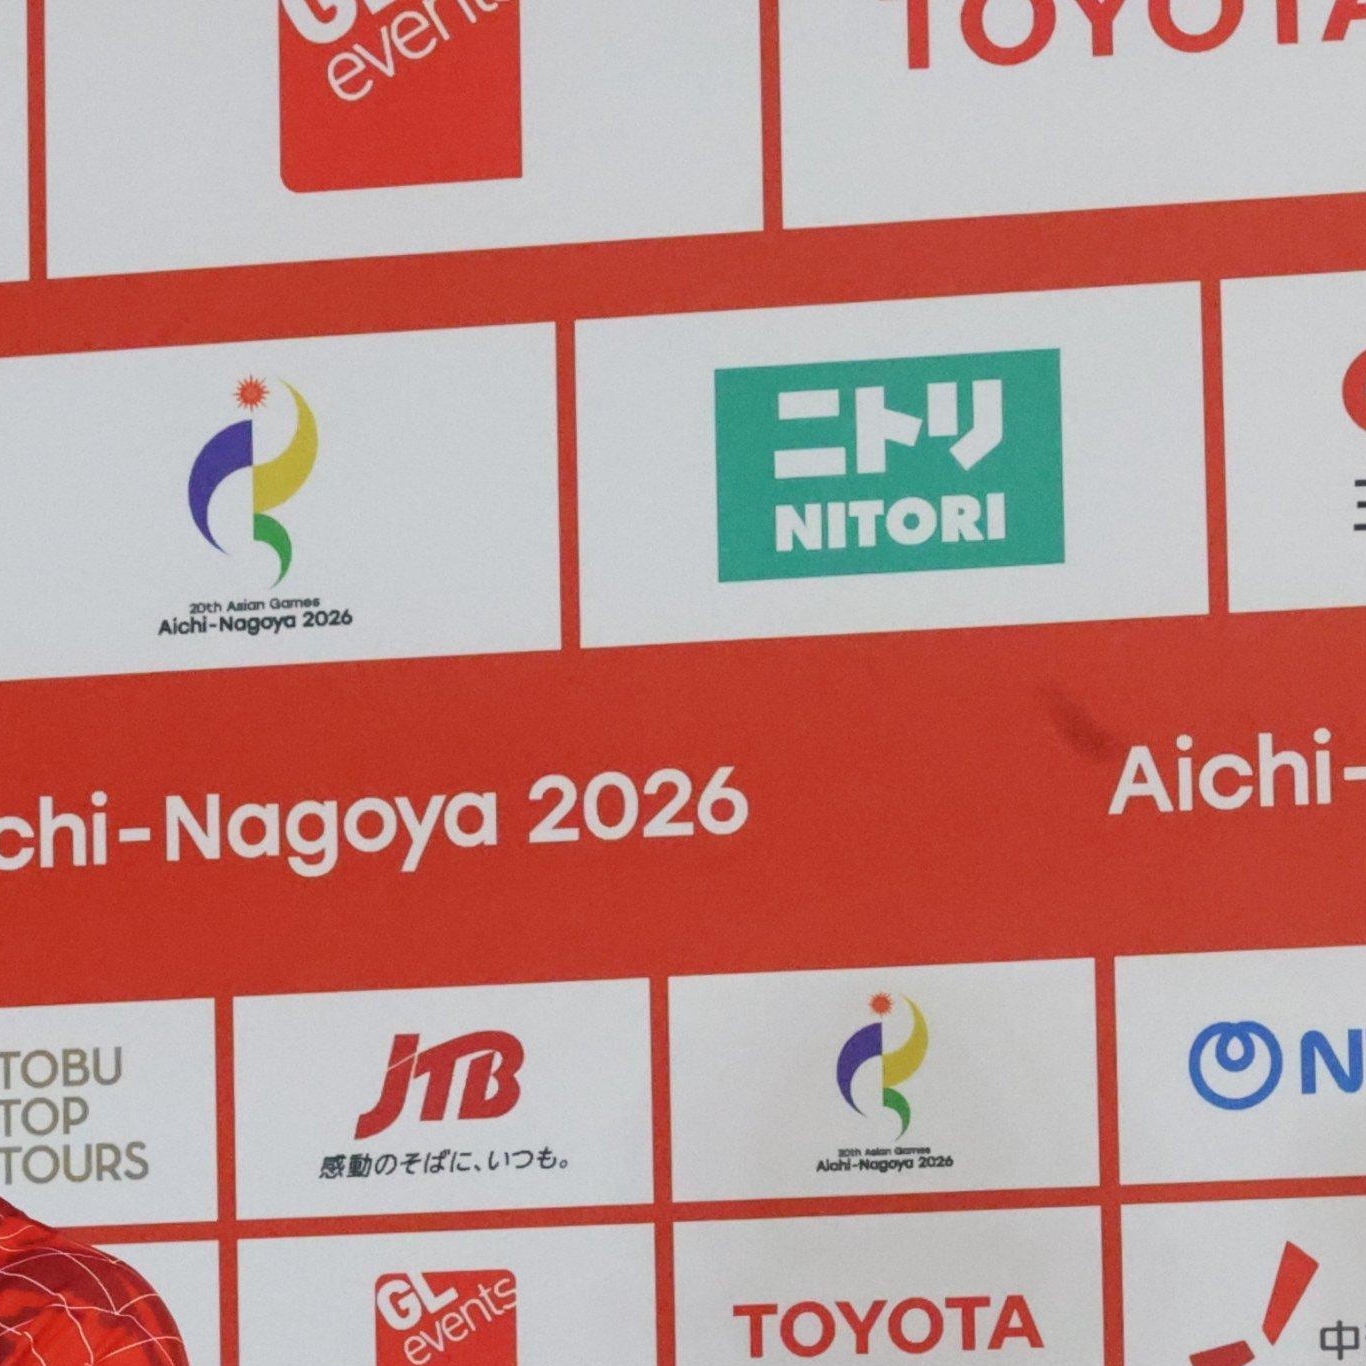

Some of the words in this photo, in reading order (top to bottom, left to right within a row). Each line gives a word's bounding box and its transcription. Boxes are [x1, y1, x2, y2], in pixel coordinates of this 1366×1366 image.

[774, 379, 1004, 479] ニトリ
[775, 492, 1006, 553] NITORI
[158, 613, 296, 636] Aichi-Nagoya
[302, 609, 353, 627] 2026
[189, 601, 222, 614] 20th
[227, 598, 265, 612] Asian
[269, 597, 321, 610] Games
[528, 766, 749, 845] 2026
[353, 1030, 526, 1140] JTB
[319, 1146, 568, 1180] 感動のそばに、いつも。
[816, 1158, 914, 1173] Aichi-Nagoya
[918, 1155, 954, 1169] 2026
[377, 1272, 459, 1331] GL
[403, 1278, 517, 1366] events
[733, 1295, 1045, 1360] TOYOTA
